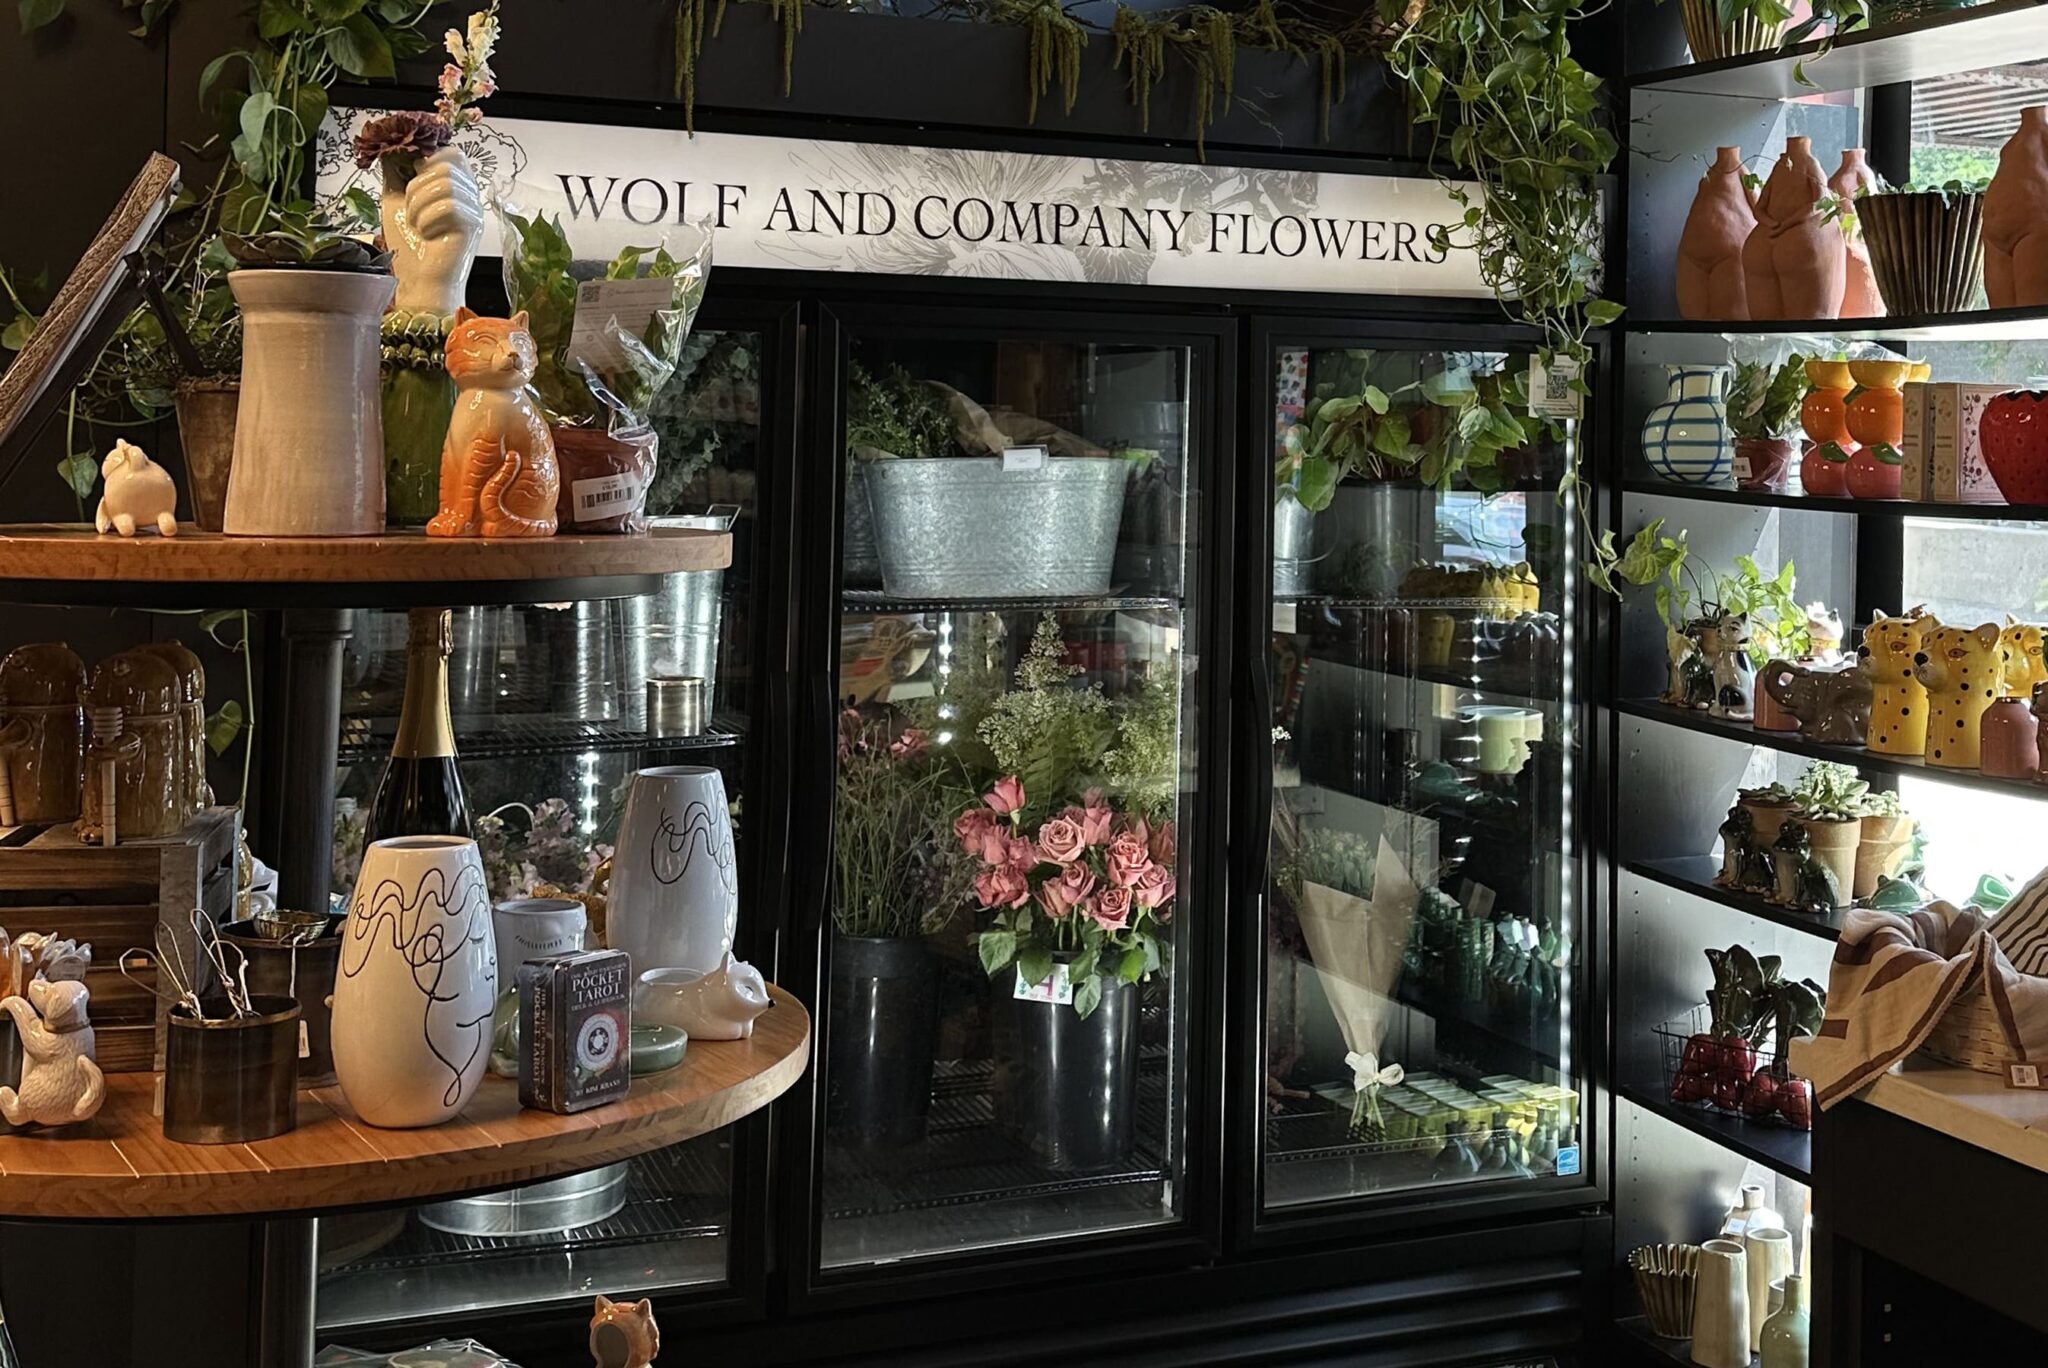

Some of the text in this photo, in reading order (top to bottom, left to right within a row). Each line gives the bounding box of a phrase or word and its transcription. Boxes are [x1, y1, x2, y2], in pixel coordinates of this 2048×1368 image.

[554, 174, 1449, 264] WOLF AND COMPANY FLOWERS
[572, 969, 623, 992] POCKET
[576, 982, 623, 1004] TAROT
